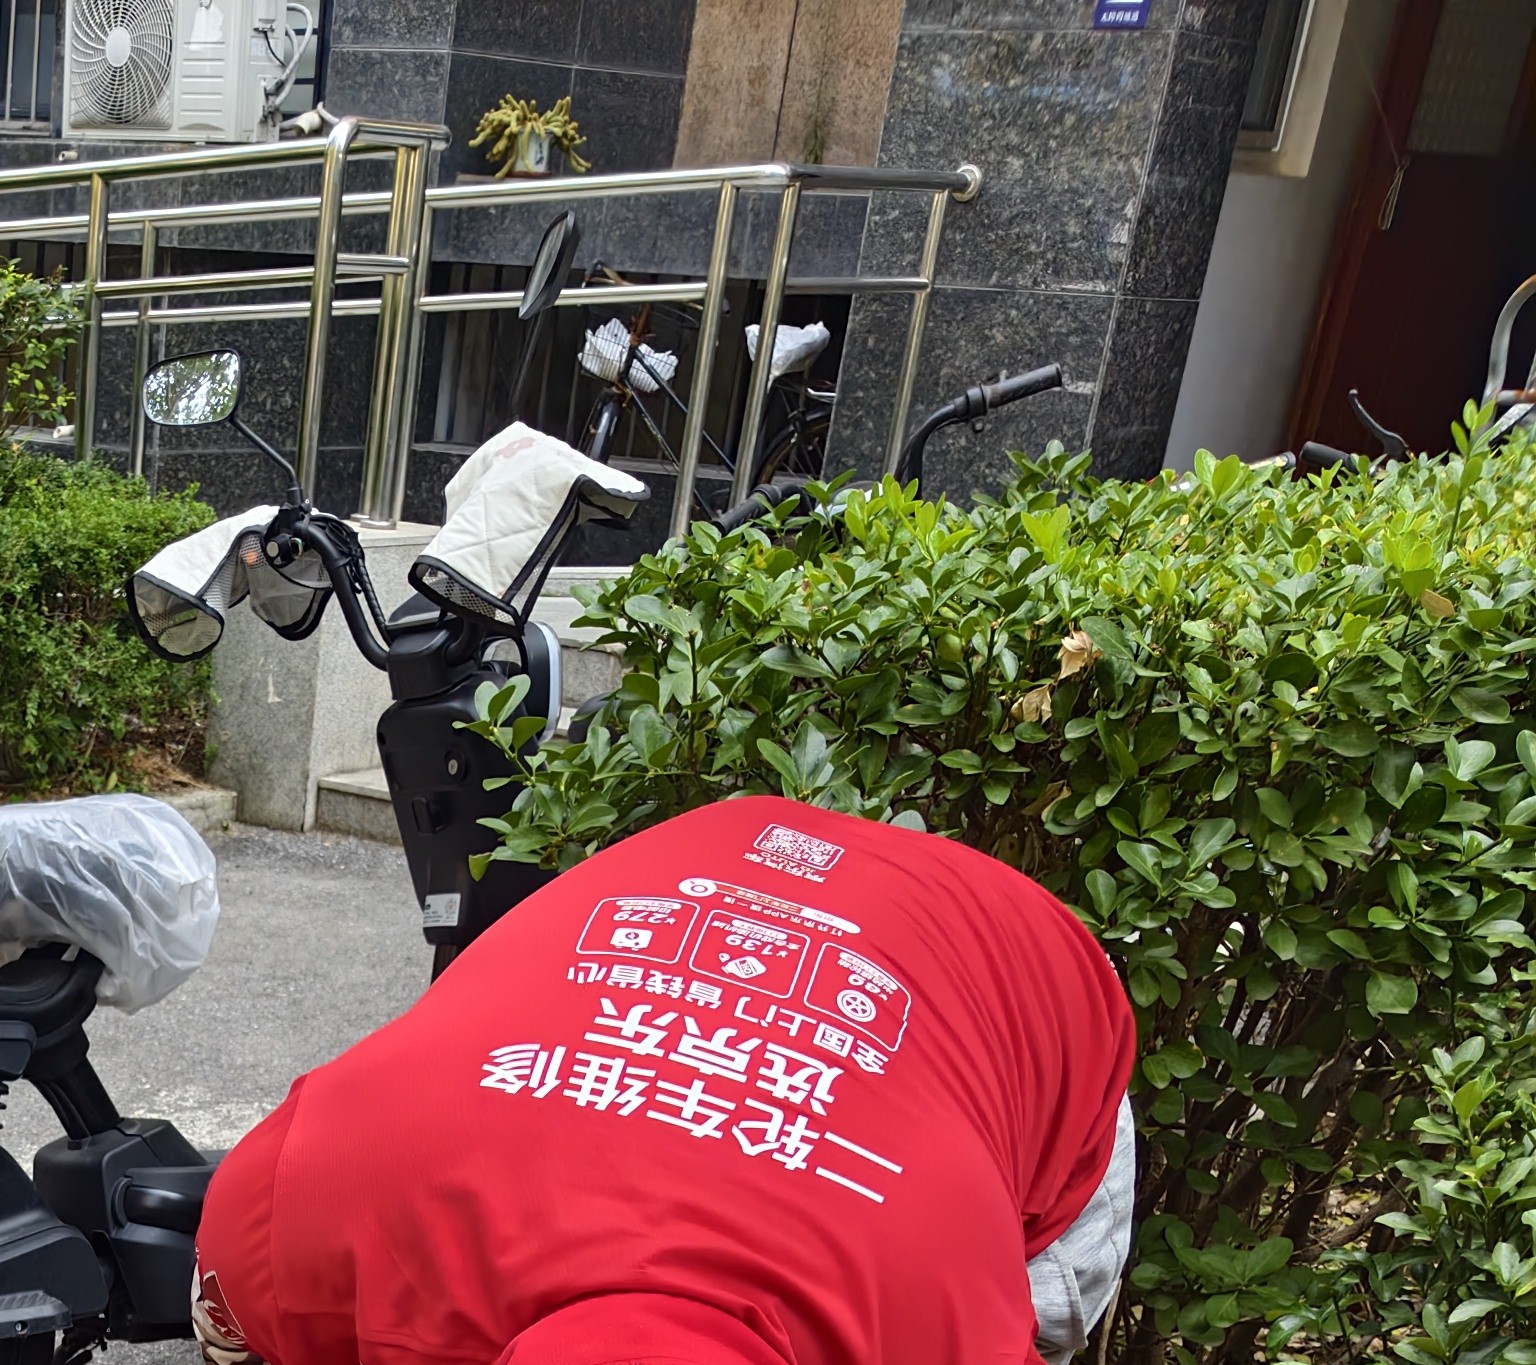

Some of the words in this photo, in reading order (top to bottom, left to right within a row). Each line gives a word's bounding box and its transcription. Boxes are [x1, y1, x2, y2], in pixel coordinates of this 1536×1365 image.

[567, 960, 723, 1010] 省钱省心
[584, 998, 844, 1116] 选京东
[733, 996, 889, 1075] 全国上门
[478, 1042, 903, 1204] 二轮车维修
